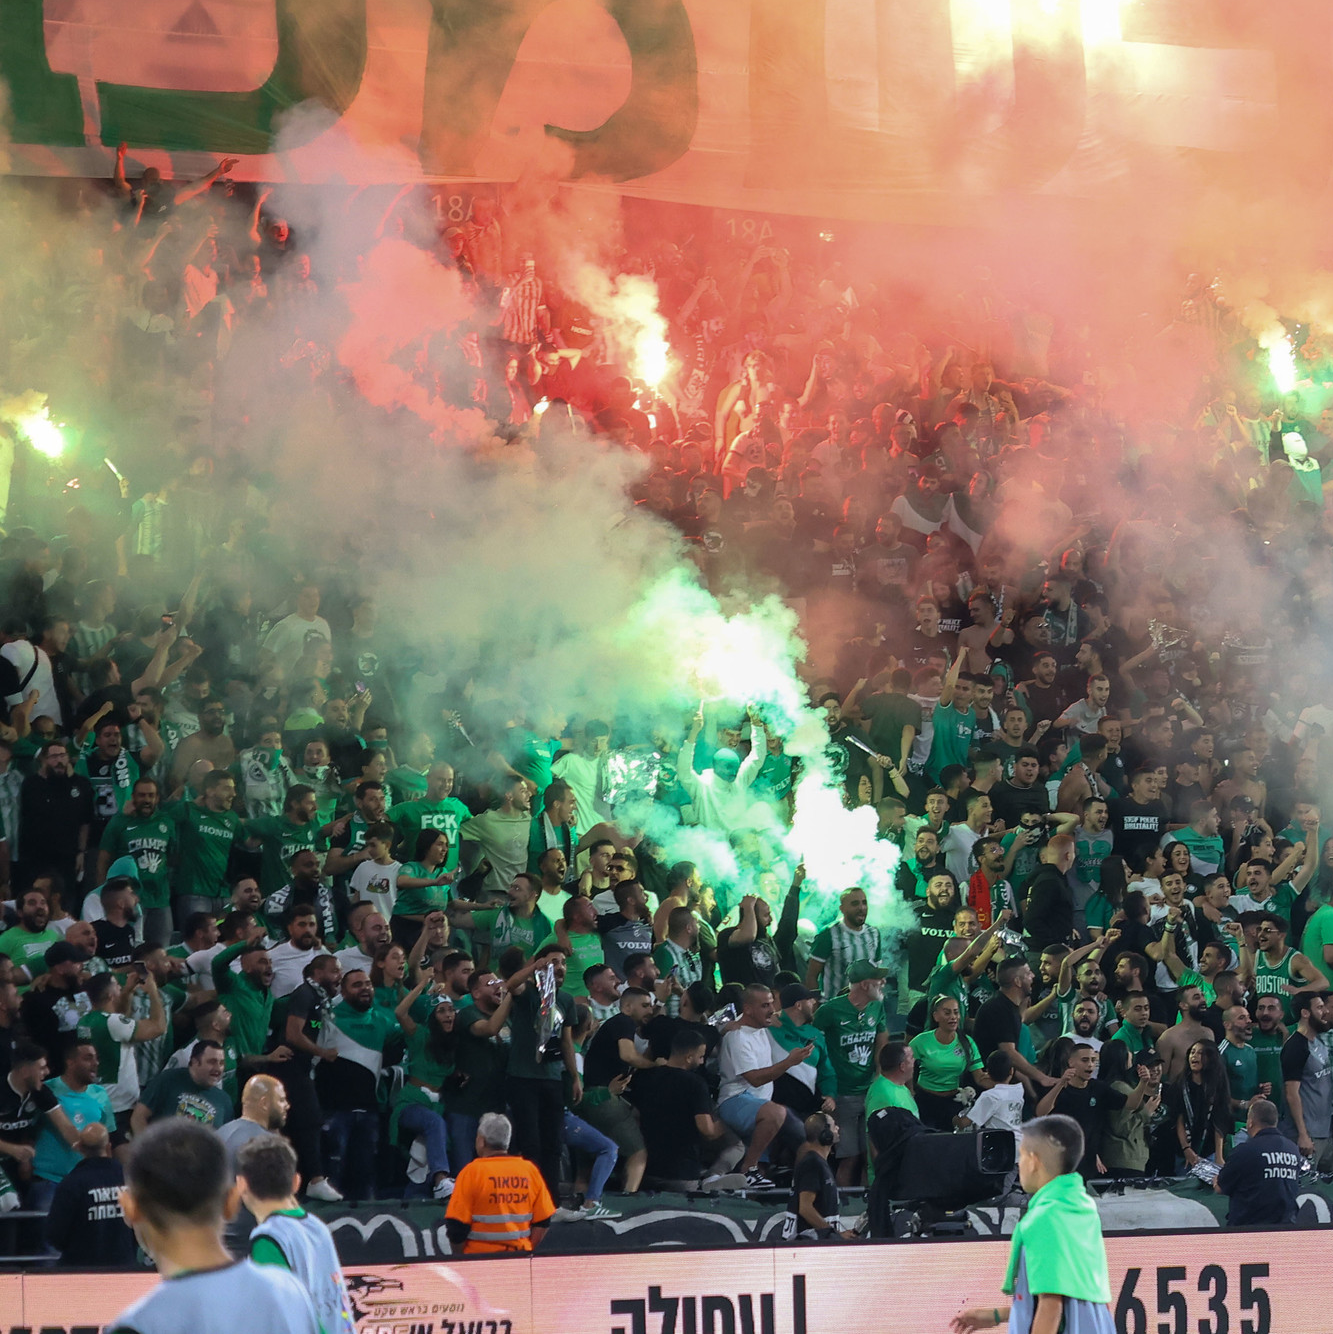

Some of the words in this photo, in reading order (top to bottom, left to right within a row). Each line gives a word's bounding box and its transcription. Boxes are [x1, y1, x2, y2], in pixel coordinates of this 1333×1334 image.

[421, 814, 458, 830] FCK
[1255, 975, 1289, 995] BOSTON
[1262, 1151, 1299, 1166] מטאור
[1264, 1167, 1297, 1180] אבטחה
[488, 1176, 529, 1189] מטאור
[488, 1192, 529, 1205] אבטחה
[1114, 1263, 1271, 1334] 6535
